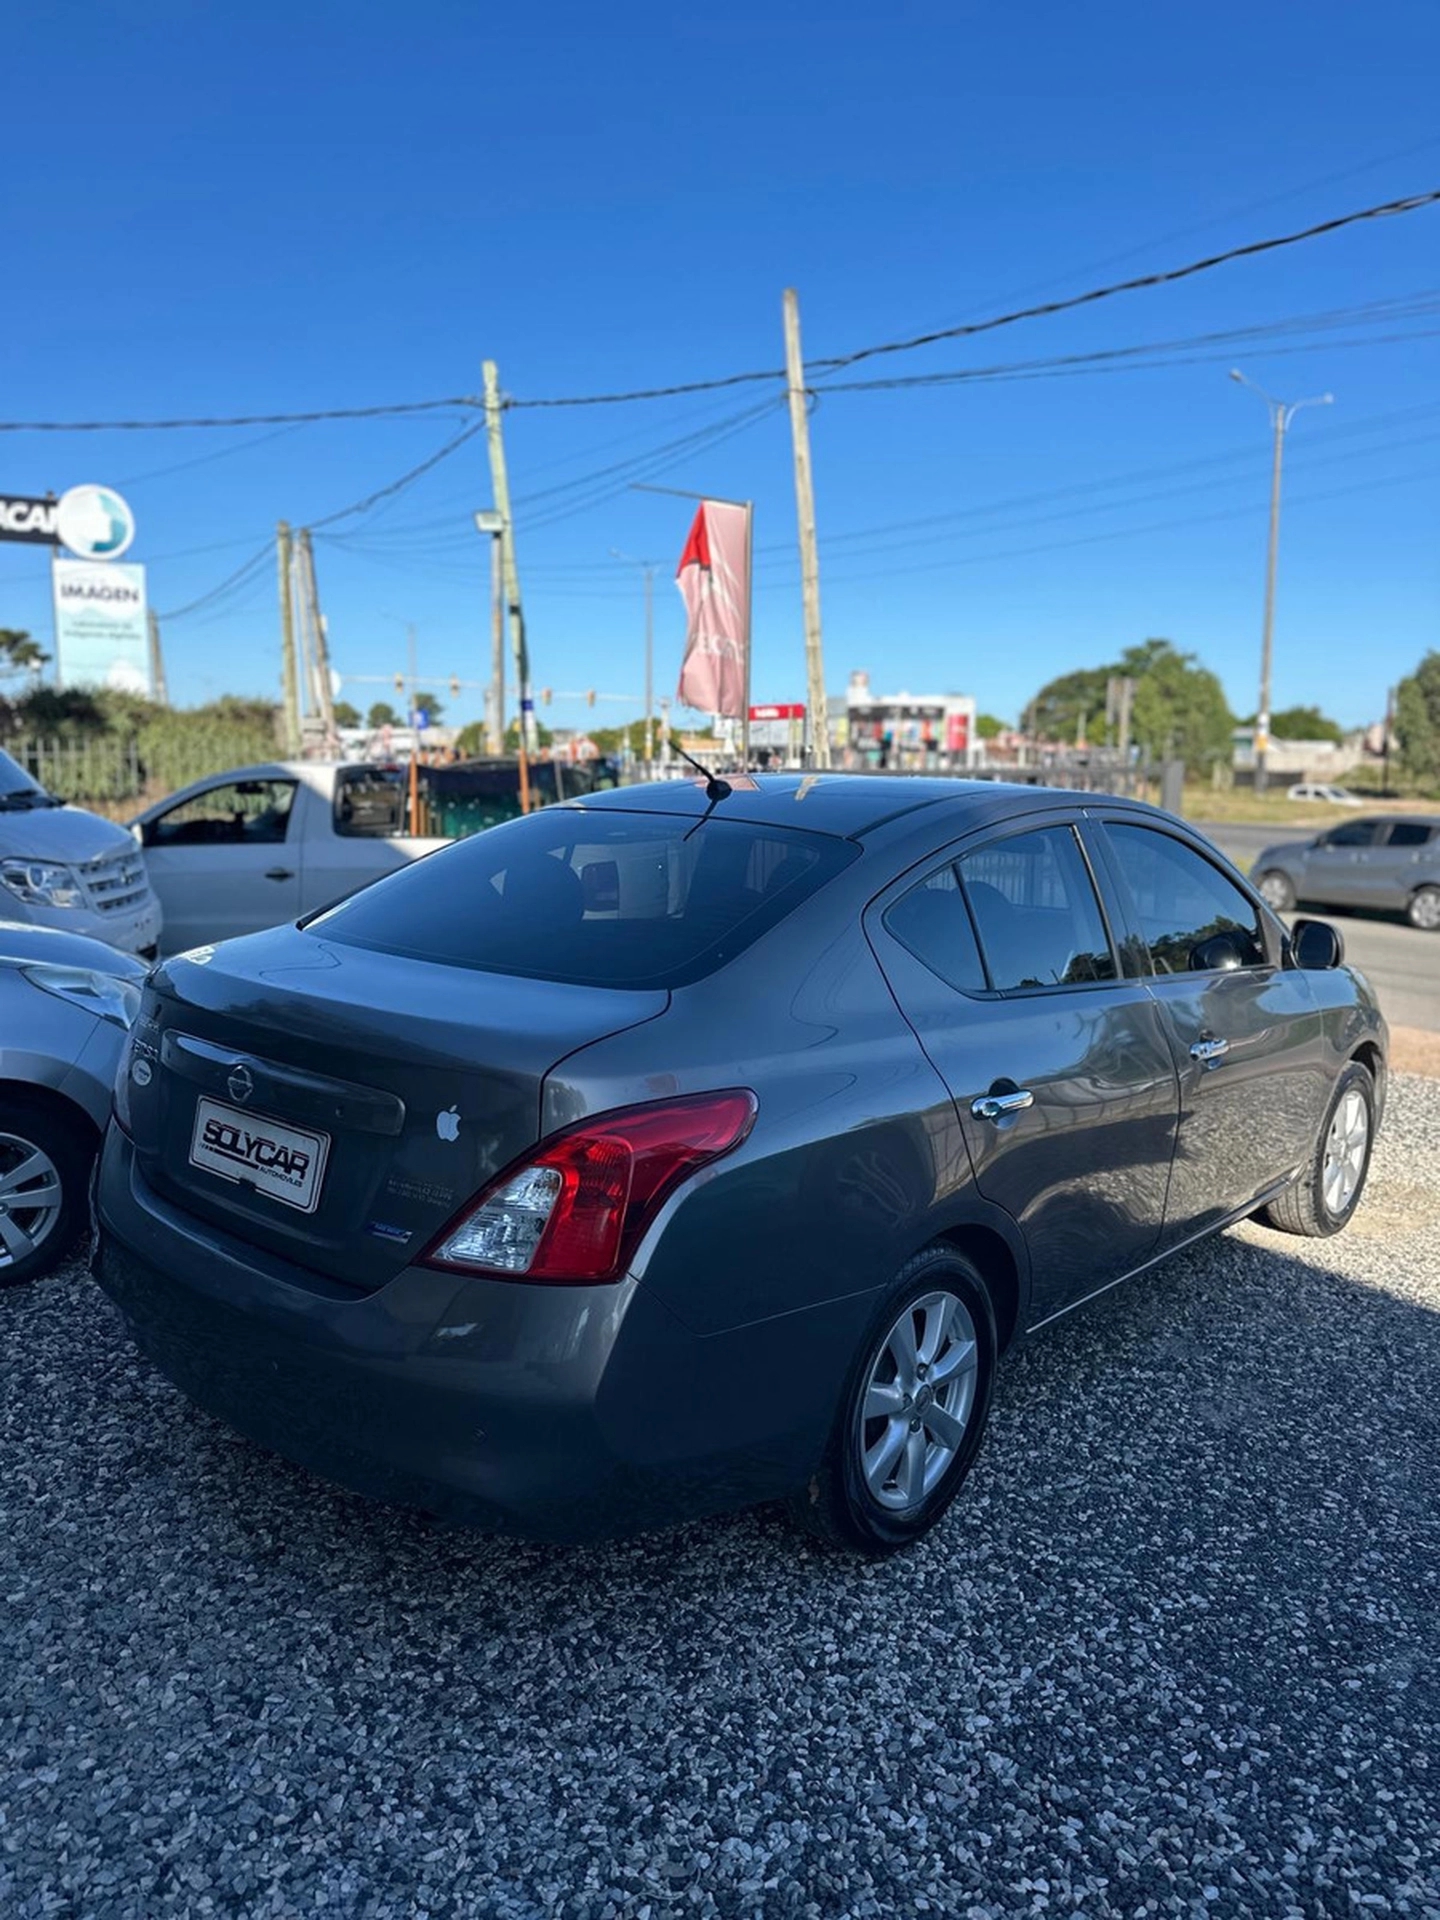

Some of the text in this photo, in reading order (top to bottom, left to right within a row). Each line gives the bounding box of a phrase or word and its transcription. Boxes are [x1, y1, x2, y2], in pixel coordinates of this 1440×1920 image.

[0, 500, 59, 534] CA
[61, 585, 139, 602] IMAGEN
[202, 1118, 310, 1180] SOLYCAR
